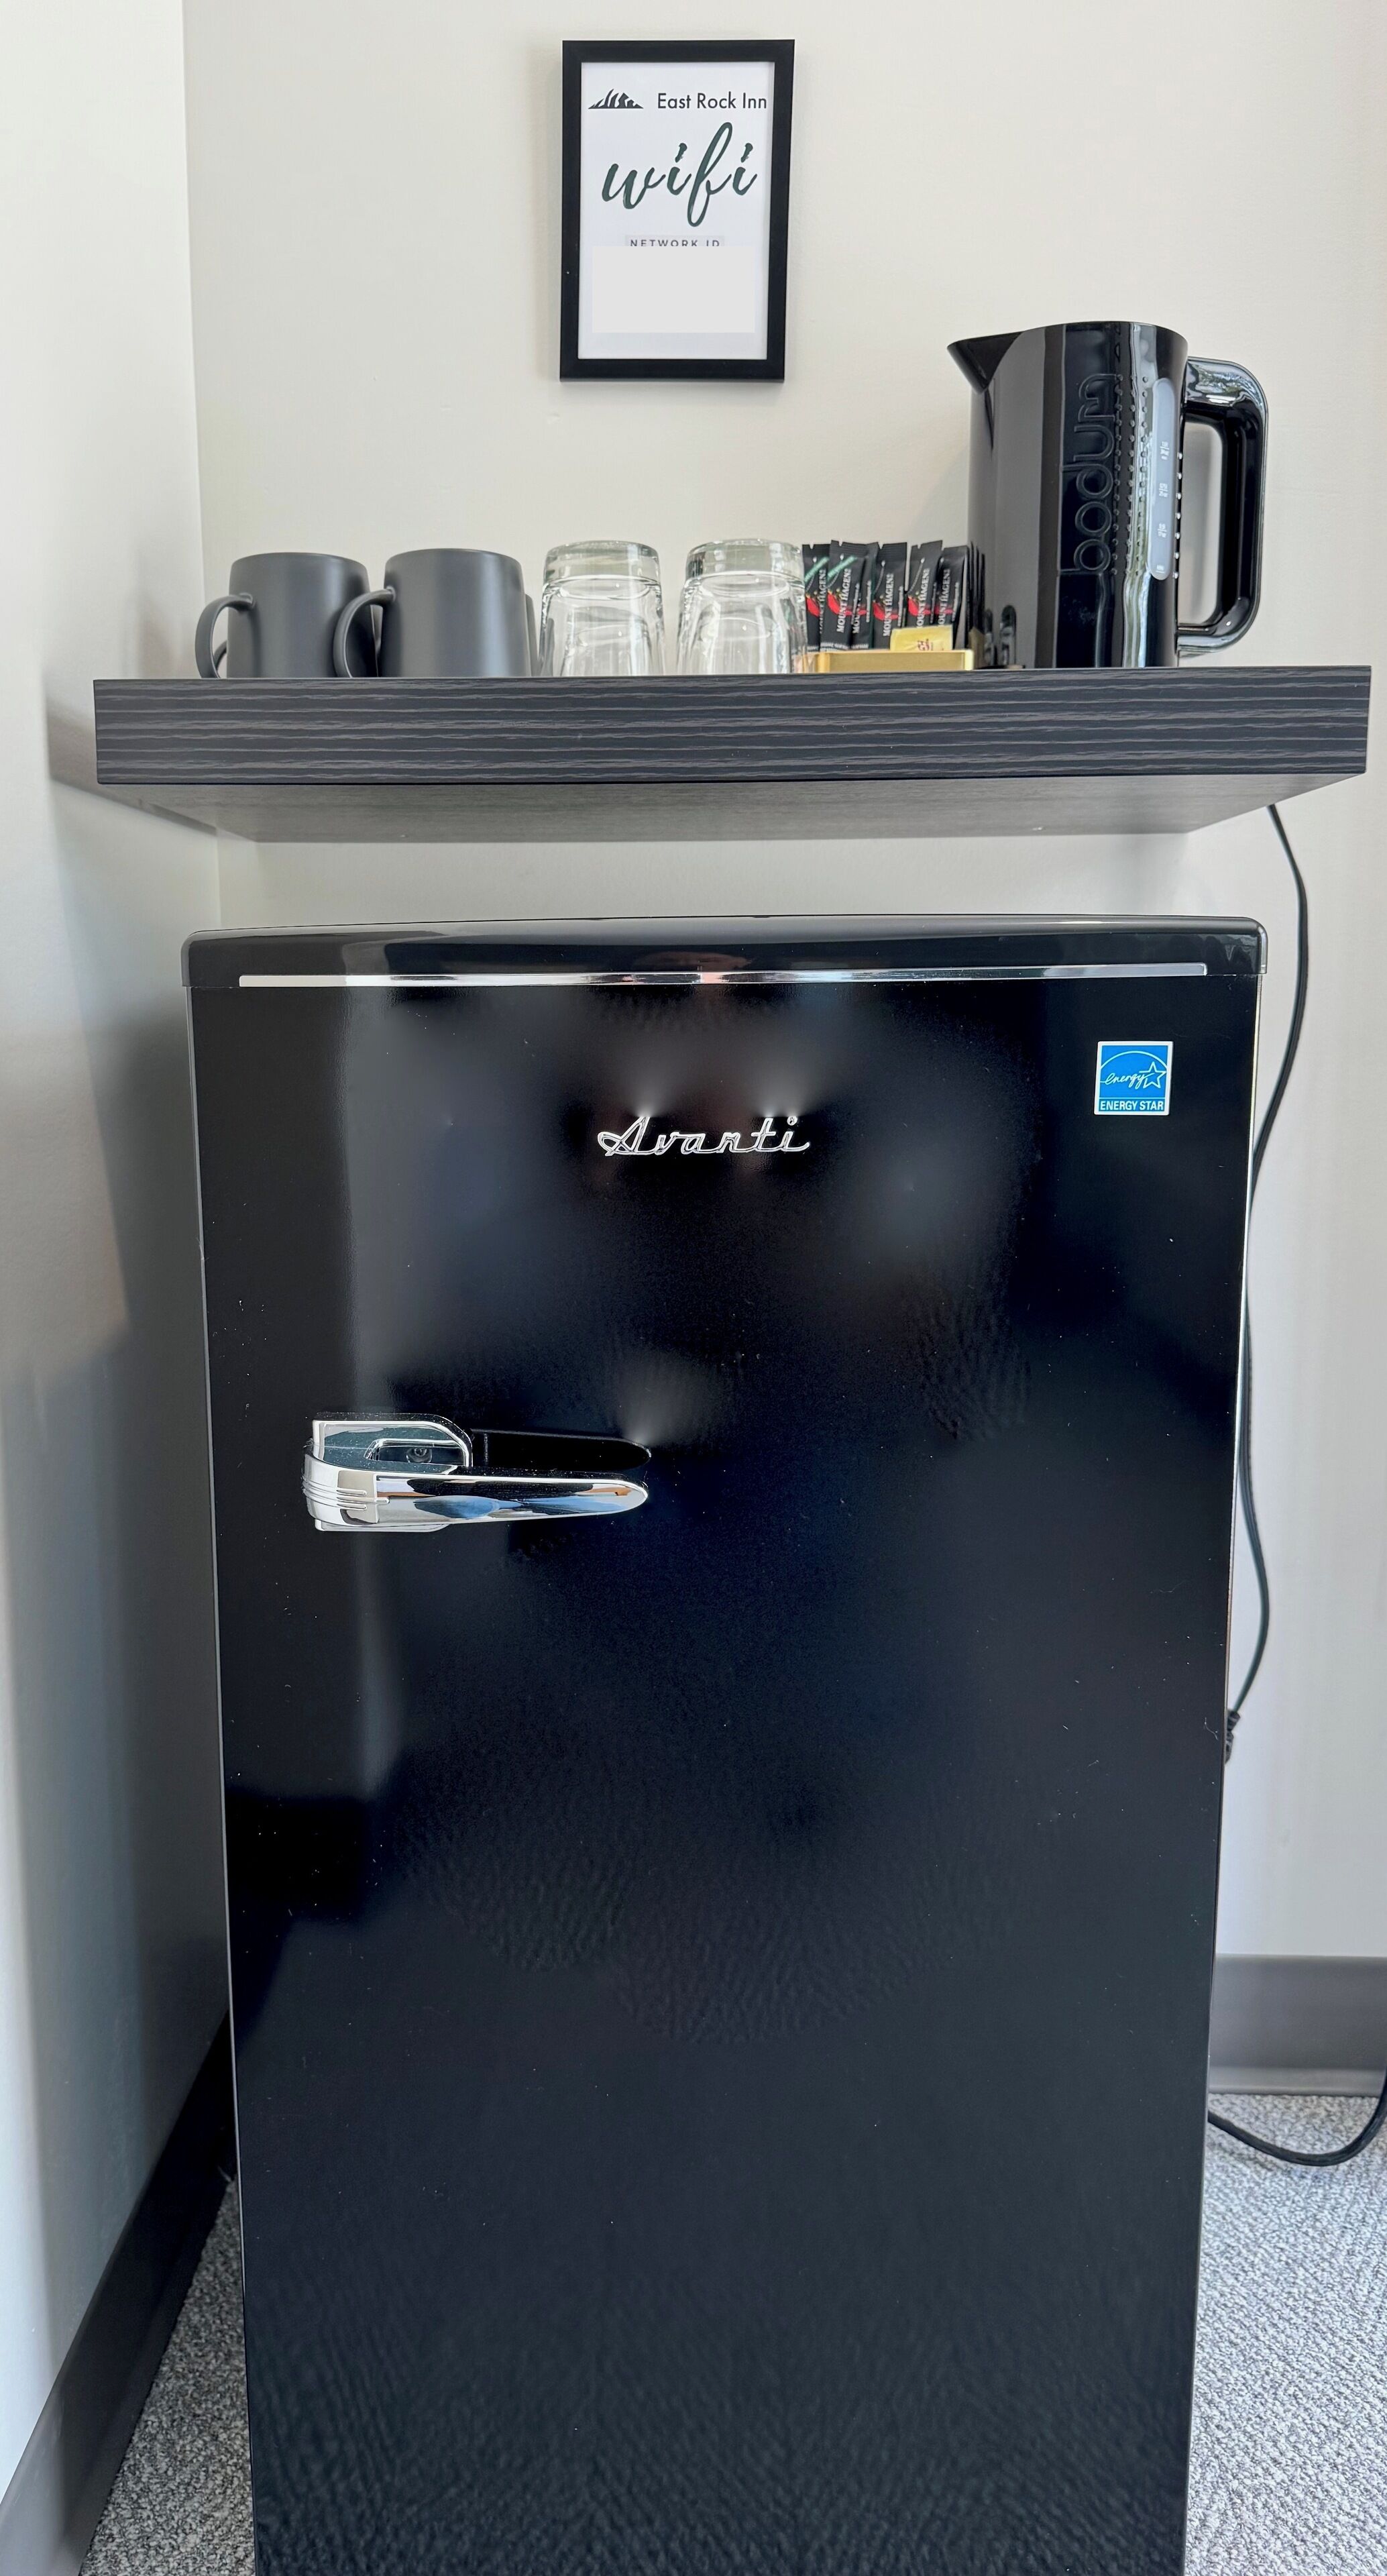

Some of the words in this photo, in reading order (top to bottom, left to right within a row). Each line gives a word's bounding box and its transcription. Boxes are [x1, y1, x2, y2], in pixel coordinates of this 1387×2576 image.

[658, 93, 691, 109] East
[697, 91, 736, 109] Rock
[742, 92, 767, 109] Inn
[602, 122, 758, 227] wifi
[630, 239, 698, 247] NETWORK
[1059, 373, 1116, 575] bodum
[916, 602, 927, 628] OUNT
[938, 602, 947, 627] OUNT
[1101, 1073, 1150, 1089] energy
[1100, 1100, 1138, 1110] ENERGY
[1140, 1100, 1164, 1110] STAR
[598, 1116, 810, 1157] Avanti
